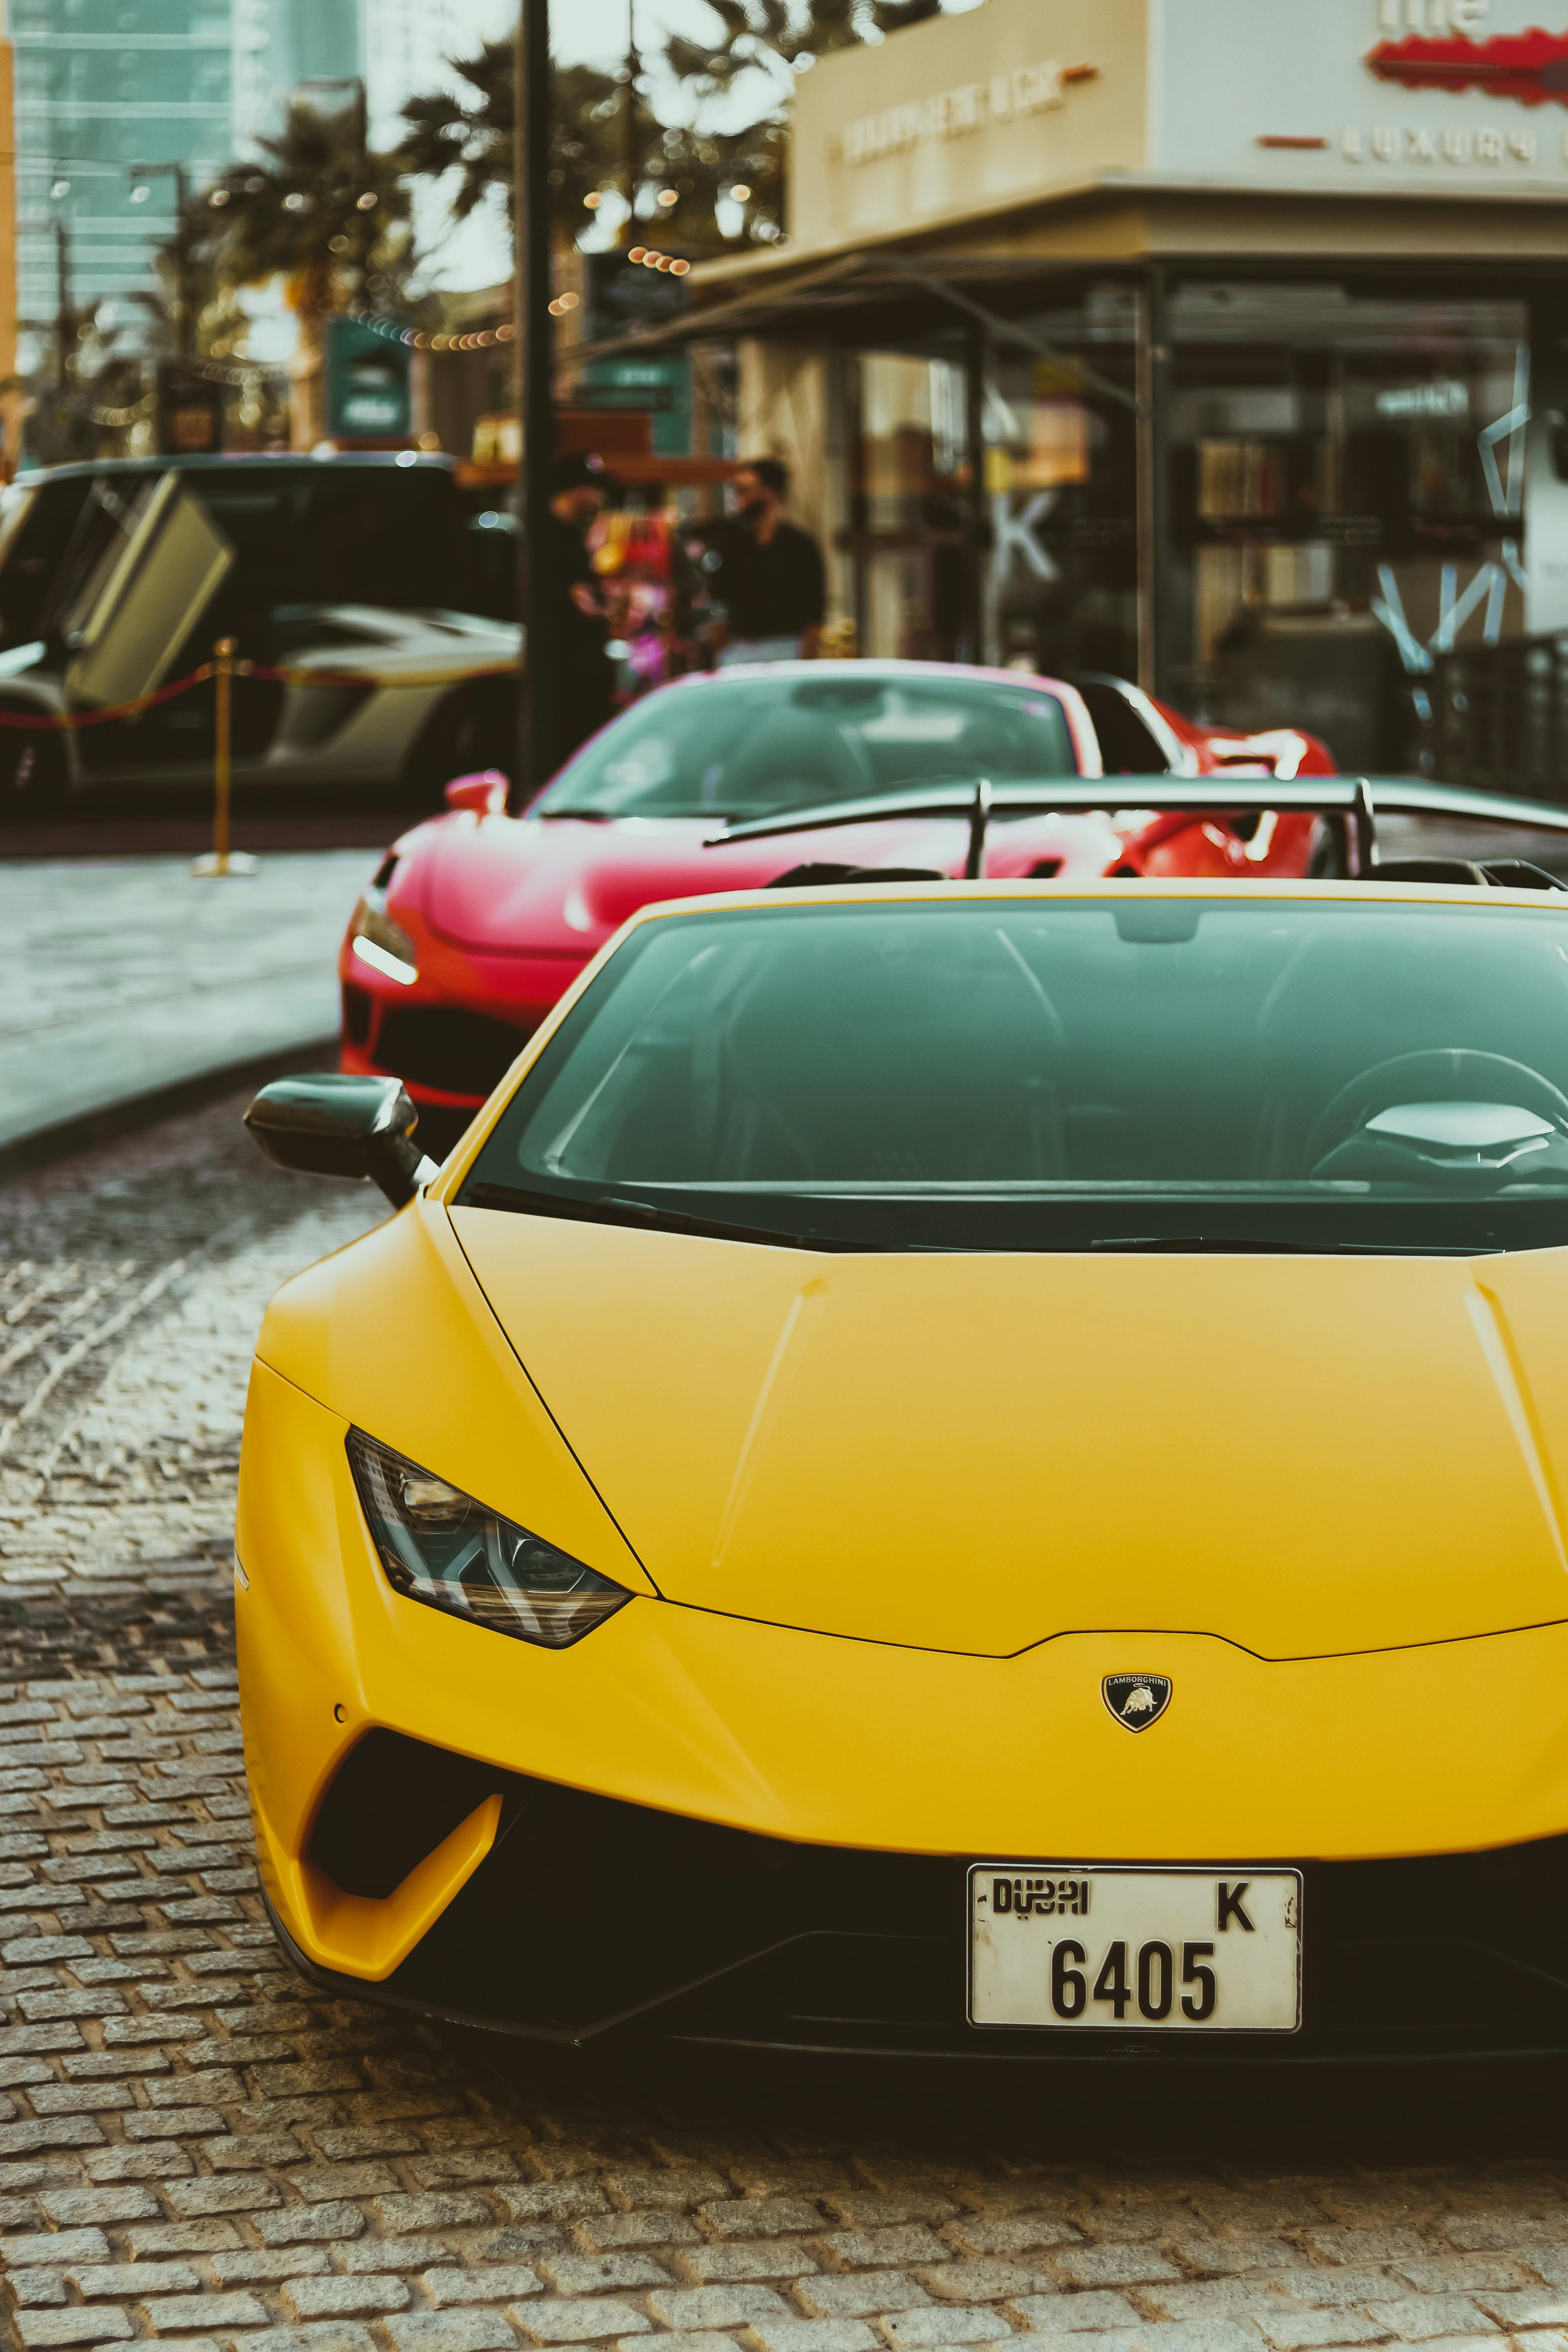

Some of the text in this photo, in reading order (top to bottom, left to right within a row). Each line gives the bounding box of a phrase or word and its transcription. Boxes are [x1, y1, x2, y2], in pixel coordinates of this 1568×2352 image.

[1339, 126, 1538, 163] LUXURY
[1109, 1677, 1166, 1686] LAMBORGHINI
[1217, 1882, 1255, 1931] K
[1051, 1938, 1216, 2021] 6405
